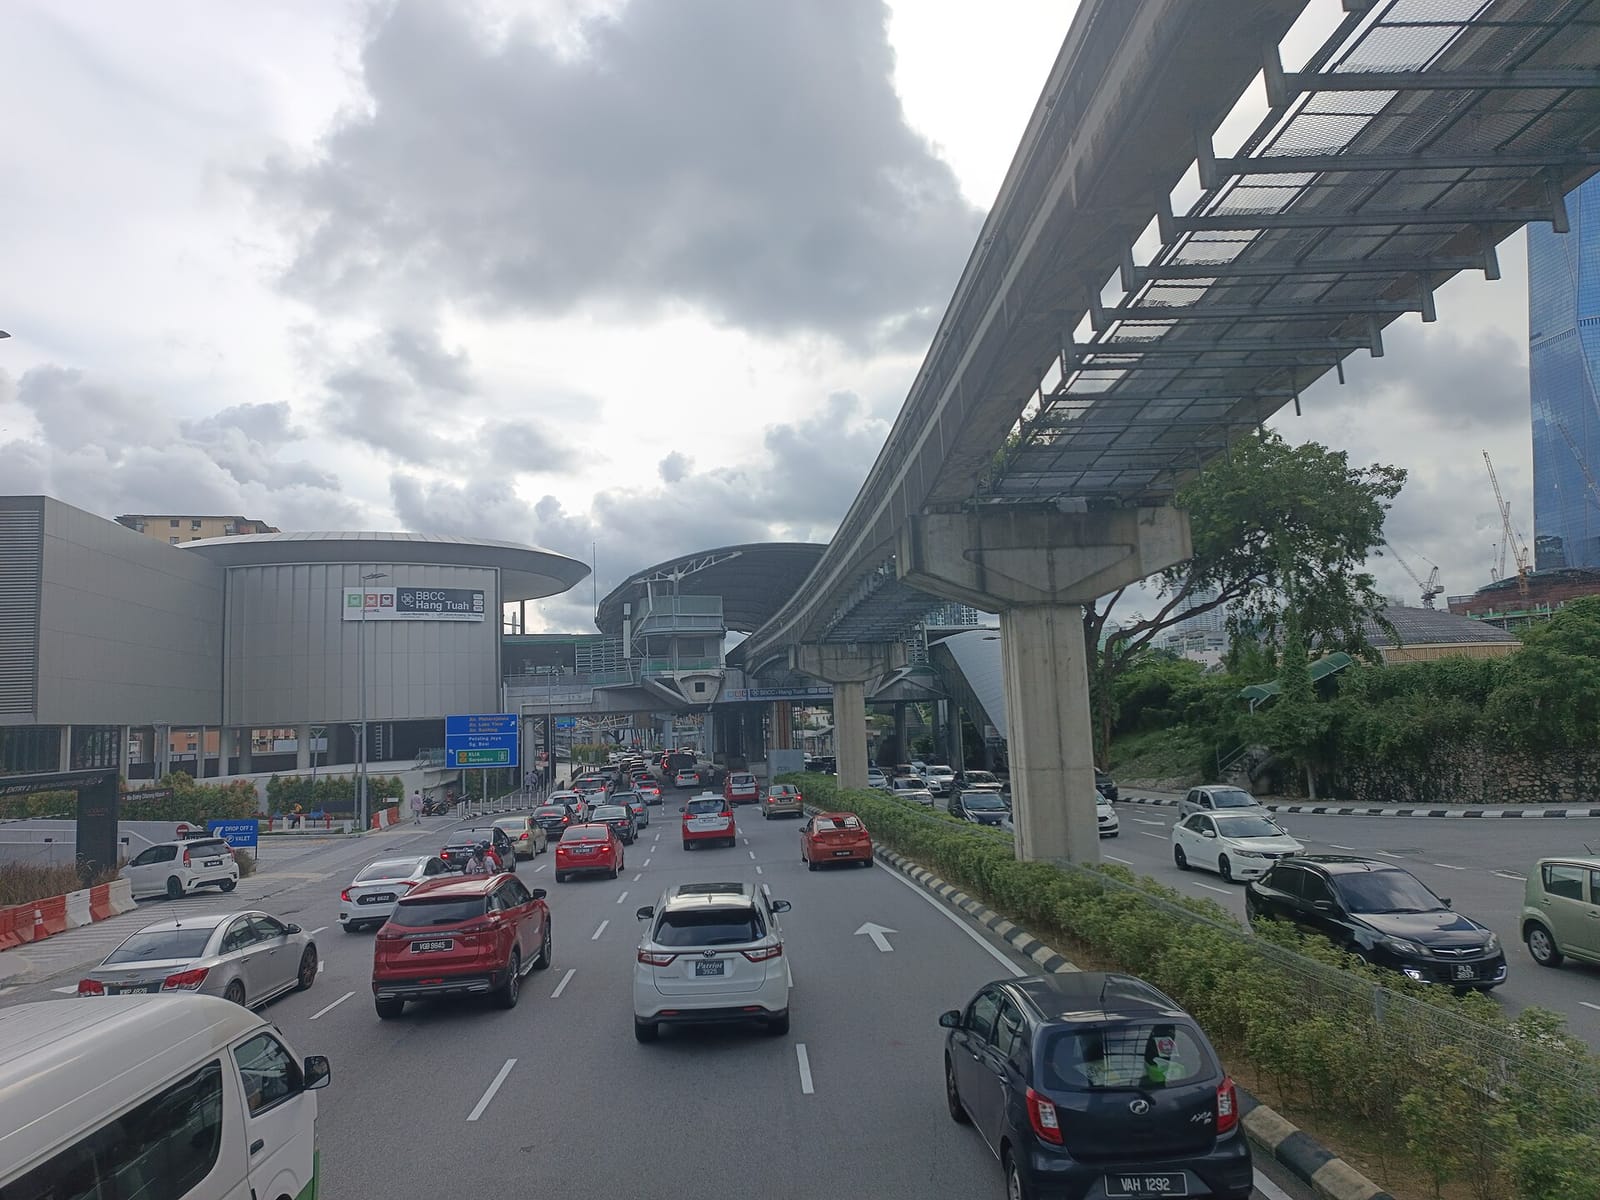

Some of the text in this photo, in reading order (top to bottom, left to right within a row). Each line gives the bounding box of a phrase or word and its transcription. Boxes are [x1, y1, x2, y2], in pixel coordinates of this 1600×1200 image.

[416, 591, 446, 601] BBCC
[416, 601, 443, 611] Hang
[446, 601, 469, 610] Tuah
[6, 785, 26, 794] ENTRY
[1120, 1177, 1171, 1191] VAH 1292
